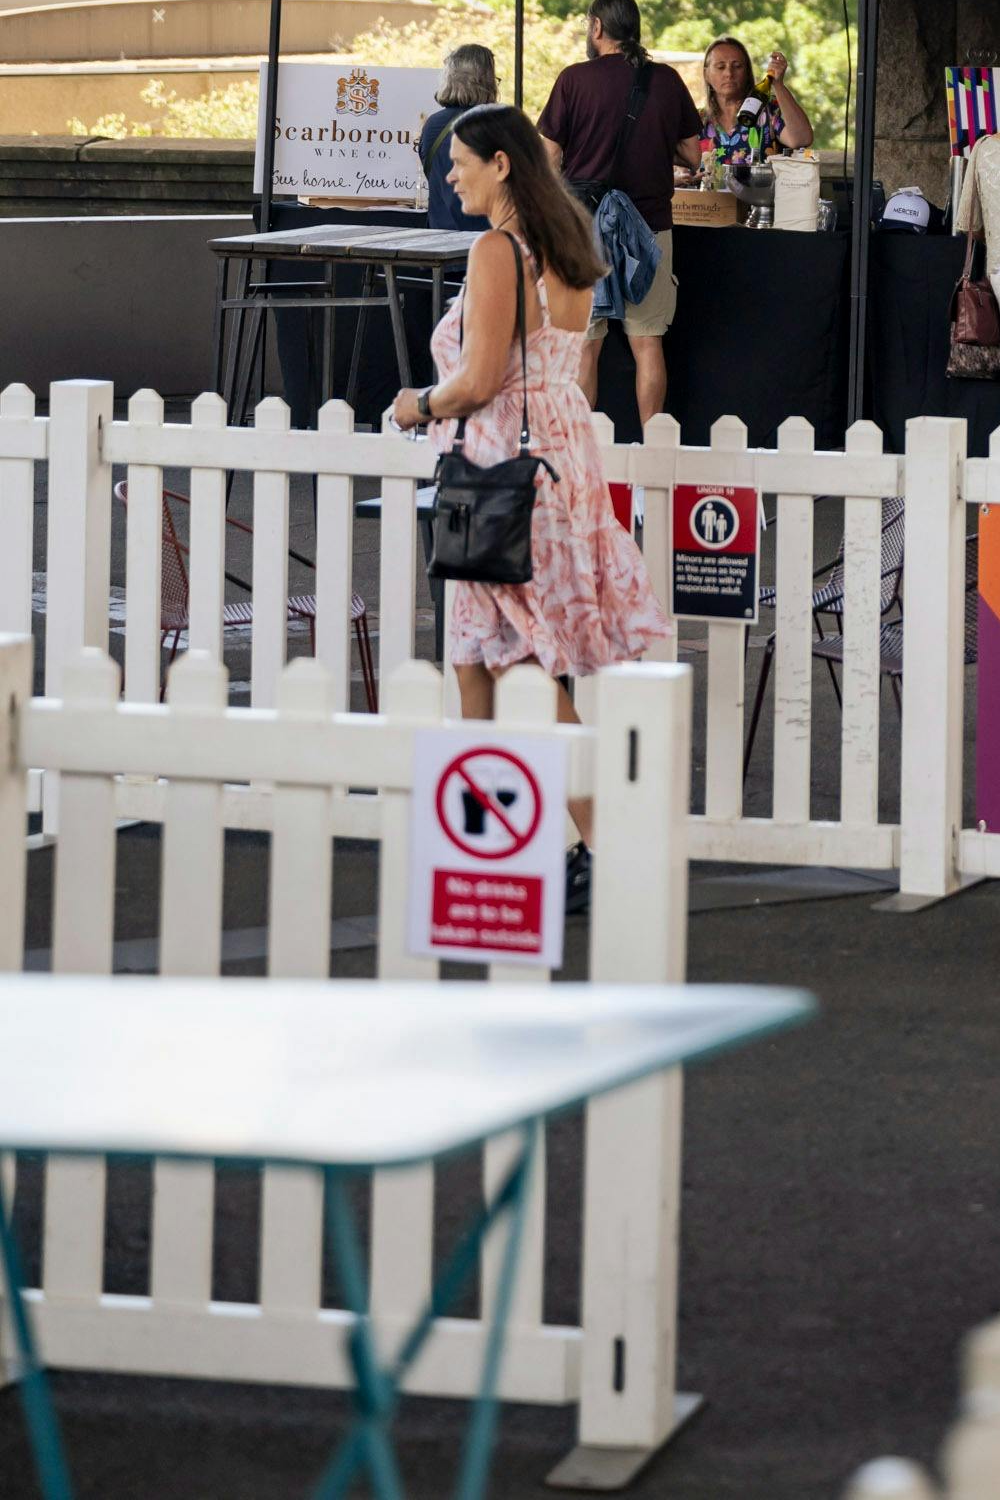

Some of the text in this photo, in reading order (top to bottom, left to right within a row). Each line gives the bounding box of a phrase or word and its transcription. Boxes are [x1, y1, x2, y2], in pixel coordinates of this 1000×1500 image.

[273, 117, 421, 153] Scarboroug
[314, 148, 392, 160] WINE CO.
[303, 169, 351, 189] home.
[356, 171, 390, 194] Your
[676, 554, 748, 566] Minors are allowed
[685, 565, 699, 573] this
[729, 567, 747, 577] long
[687, 575, 704, 583] they
[718, 577, 735, 585] with
[676, 583, 720, 594] responsible
[445, 876, 528, 902] No drinks
[448, 902, 524, 925] are to be
